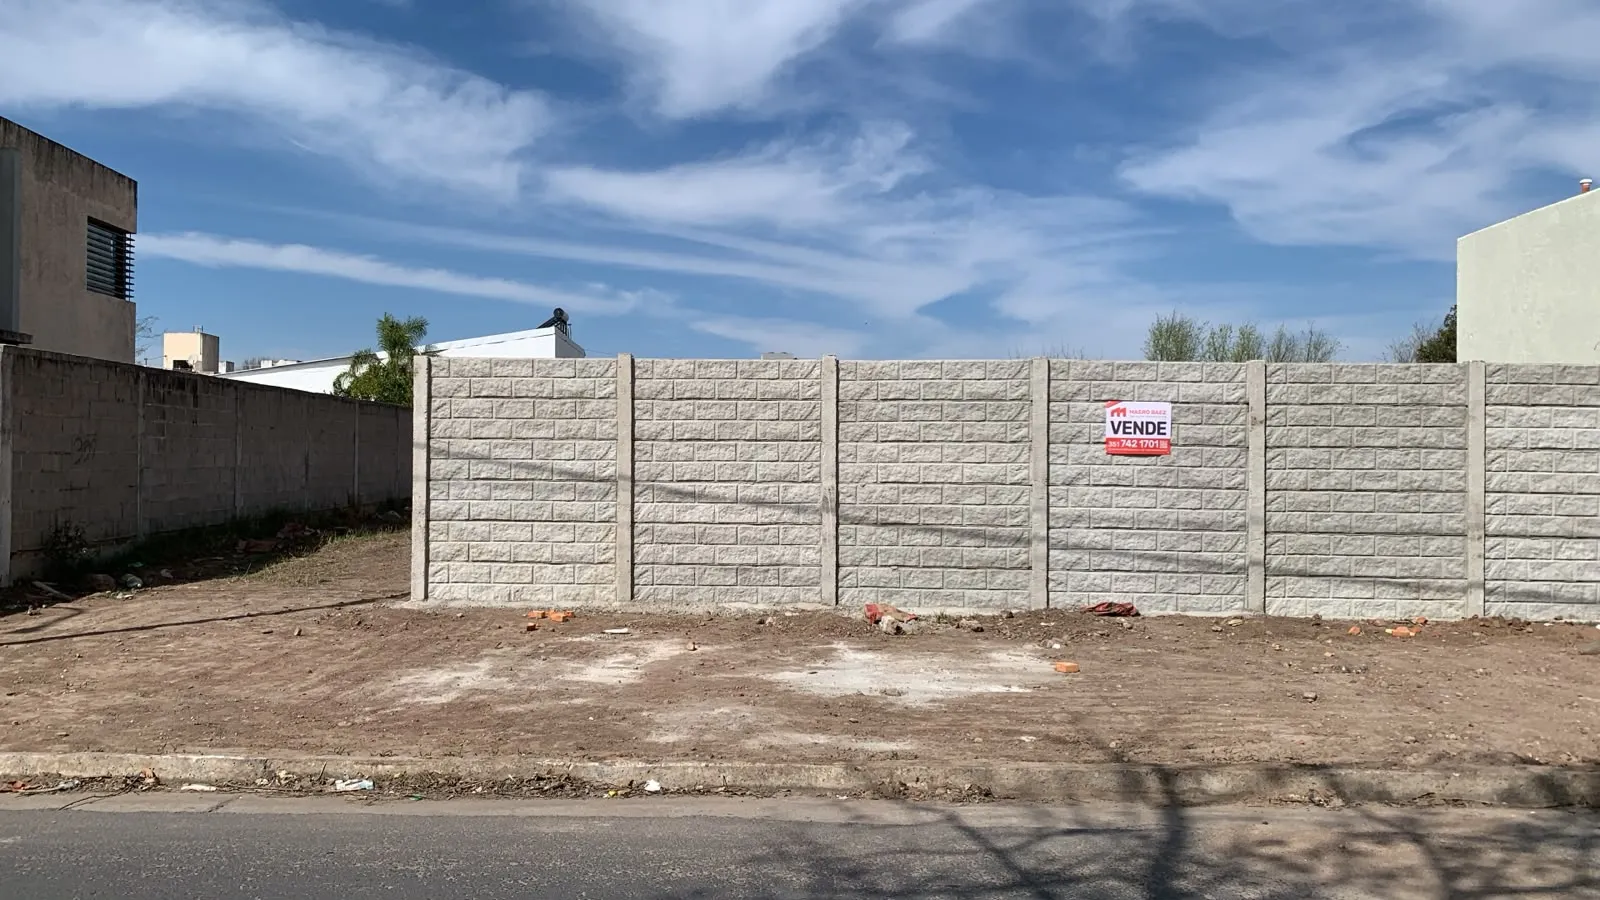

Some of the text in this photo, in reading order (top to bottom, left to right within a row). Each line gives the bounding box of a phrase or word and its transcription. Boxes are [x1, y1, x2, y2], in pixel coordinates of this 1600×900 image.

[1110, 421, 1167, 435] VENDE
[1121, 440, 1138, 448] 742
[1139, 440, 1159, 448] 1701
